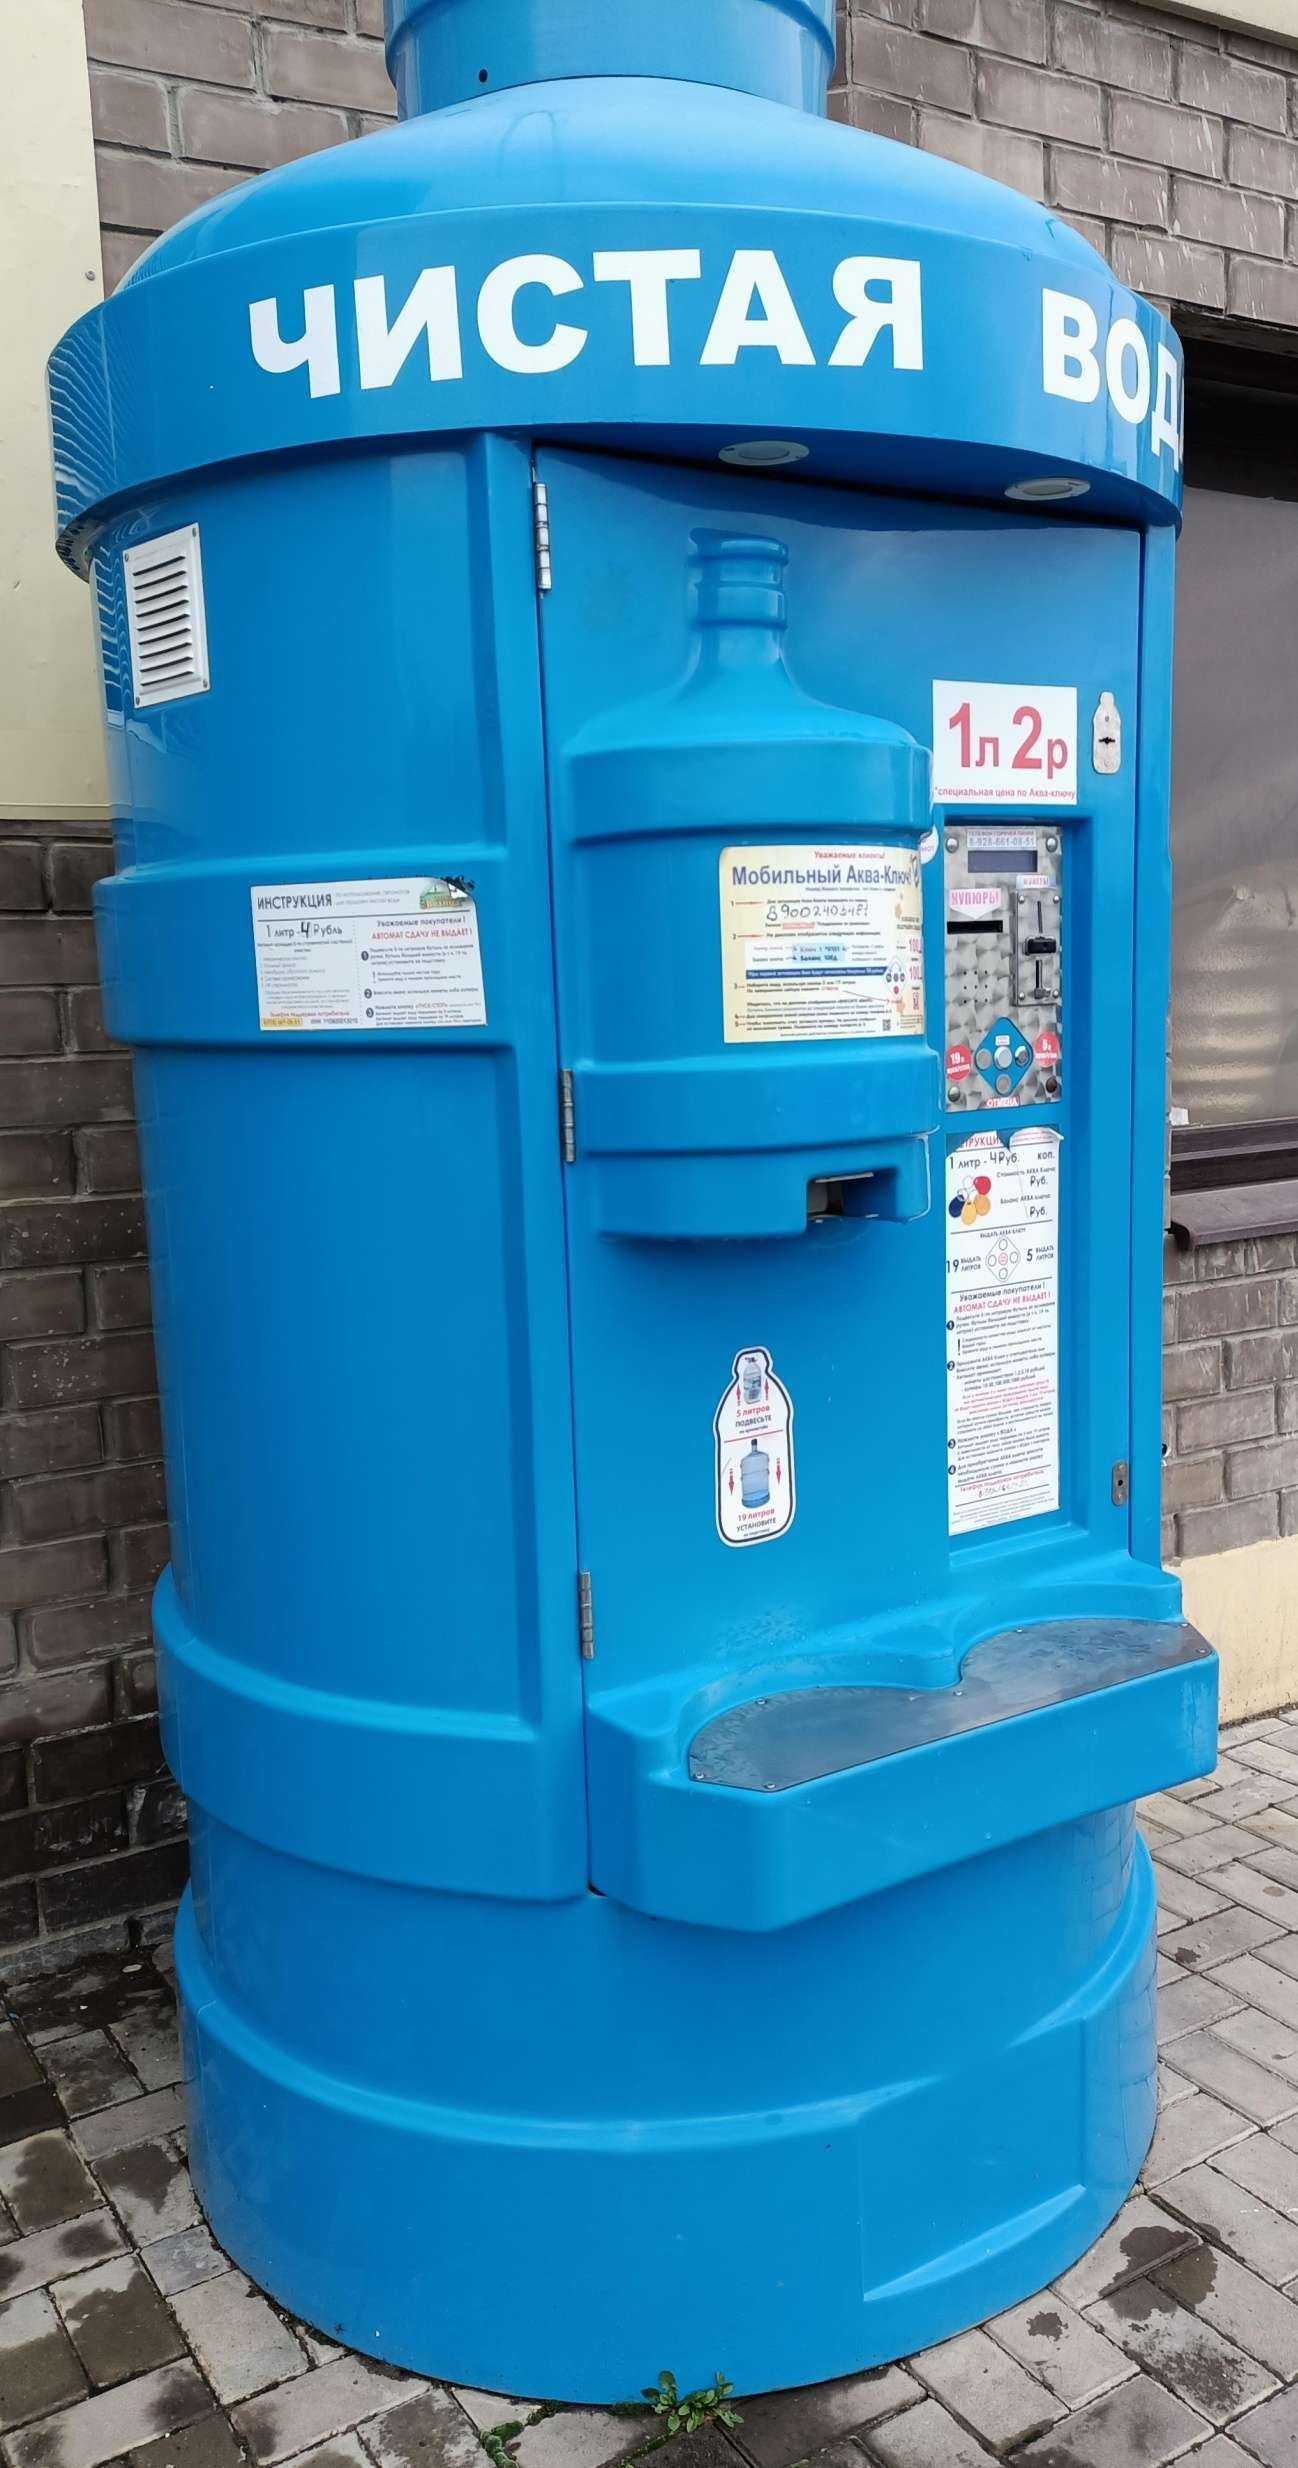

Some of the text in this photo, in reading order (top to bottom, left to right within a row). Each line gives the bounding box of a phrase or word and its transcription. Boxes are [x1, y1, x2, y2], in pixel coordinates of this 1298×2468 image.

[249, 248, 1184, 473] ЧИСТАЯ ВОД
[732, 864, 841, 886] Мобильный
[257, 893, 332, 910] ИНСТРУКЦИЯ
[958, 1158, 981, 1170] литр
[1037, 1151, 1056, 1161] коп.
[1026, 1248, 1033, 1262] 5
[946, 1259, 960, 1274] 19
[735, 1414, 772, 1428] ПОДВЕСЬТЕ
[736, 1516, 776, 1533] УСТАНОВИТЕ
